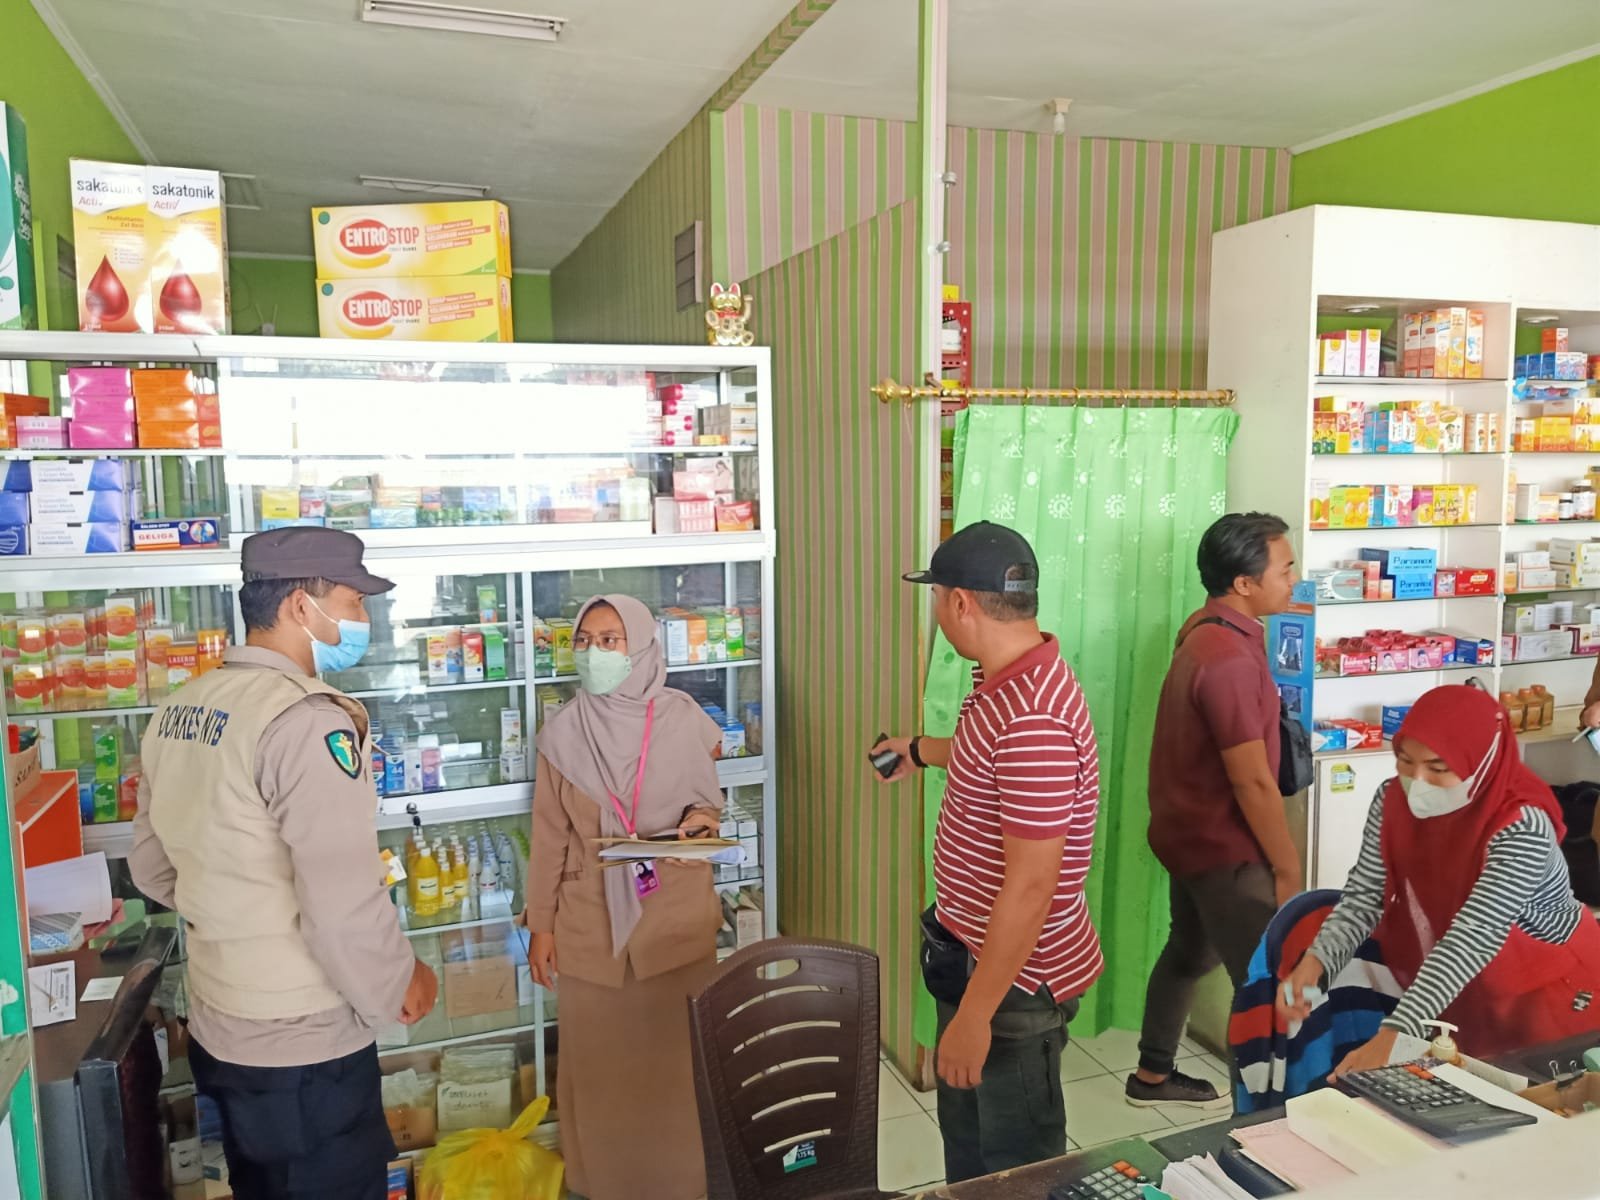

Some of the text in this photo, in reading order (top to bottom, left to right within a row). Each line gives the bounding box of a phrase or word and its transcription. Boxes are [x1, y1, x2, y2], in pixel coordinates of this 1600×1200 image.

[152, 182, 215, 199] sakatonik
[345, 226, 420, 248] ENTROSTOP
[348, 298, 423, 319] ENTROSTOP
[200, 708, 230, 747] NTB
